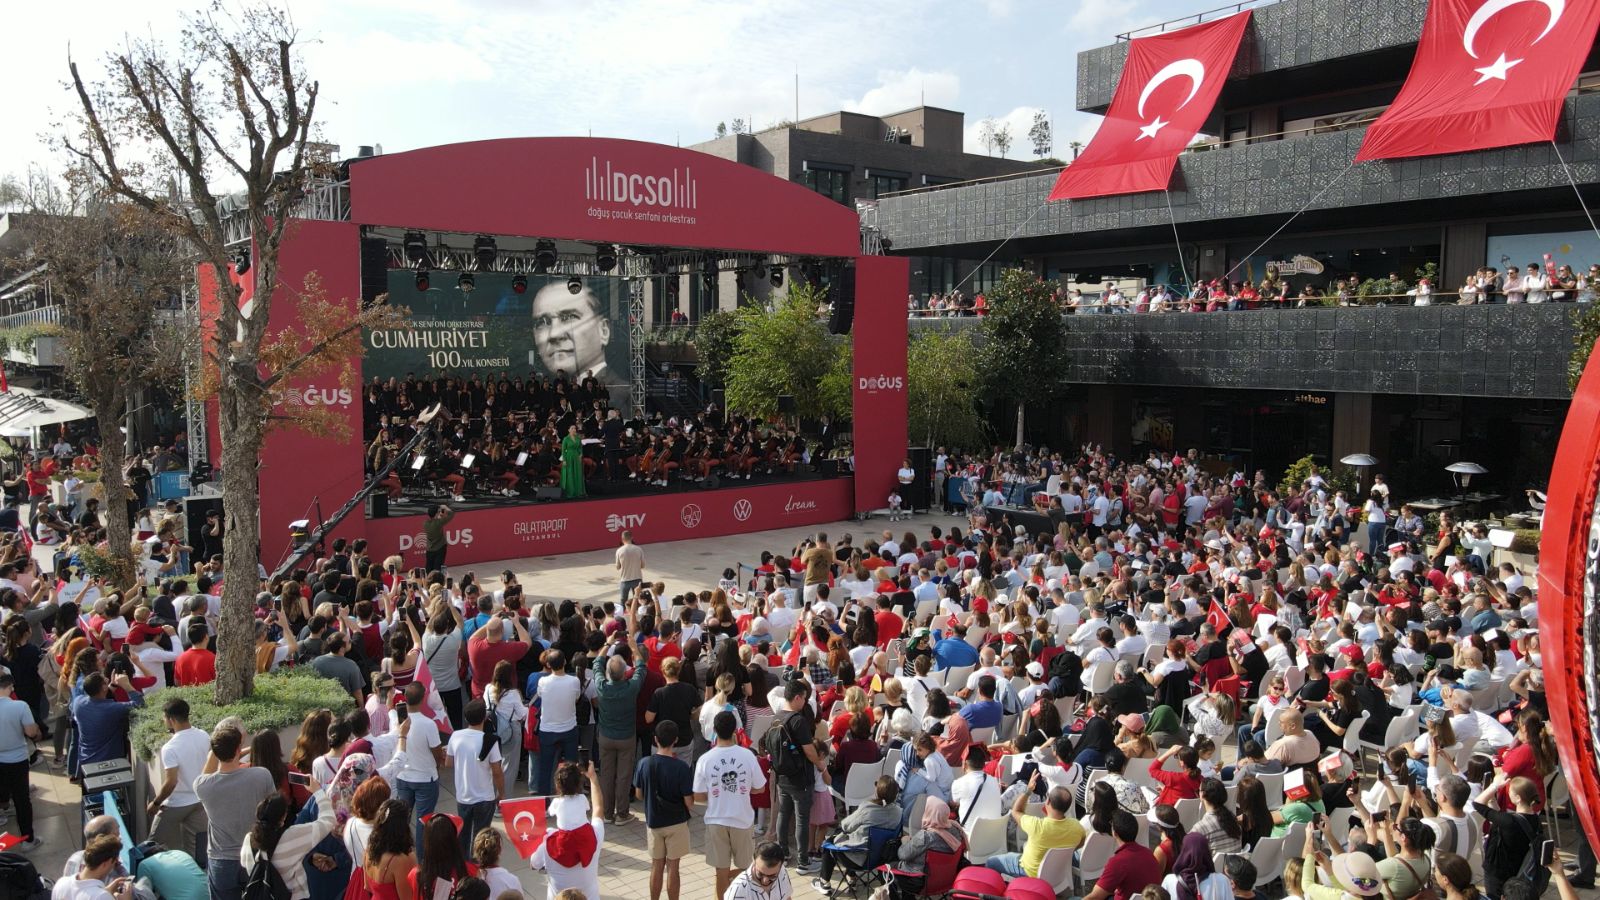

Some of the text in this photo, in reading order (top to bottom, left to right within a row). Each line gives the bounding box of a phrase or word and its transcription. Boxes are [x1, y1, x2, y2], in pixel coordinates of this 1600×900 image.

[613, 172, 672, 206] DÇSO
[587, 206, 696, 225] doğuş çocuk senfoni orkestrası
[418, 320, 446, 328] SENFONİ
[446, 320, 484, 328] ORKESTRASI
[370, 328, 489, 348] CUMHURİYET
[476, 357, 510, 368] KONSERİ
[513, 518, 569, 535] GALATAPORT
[399, 528, 474, 551] DOUŞ
[711, 757, 747, 788] ETERNITY
